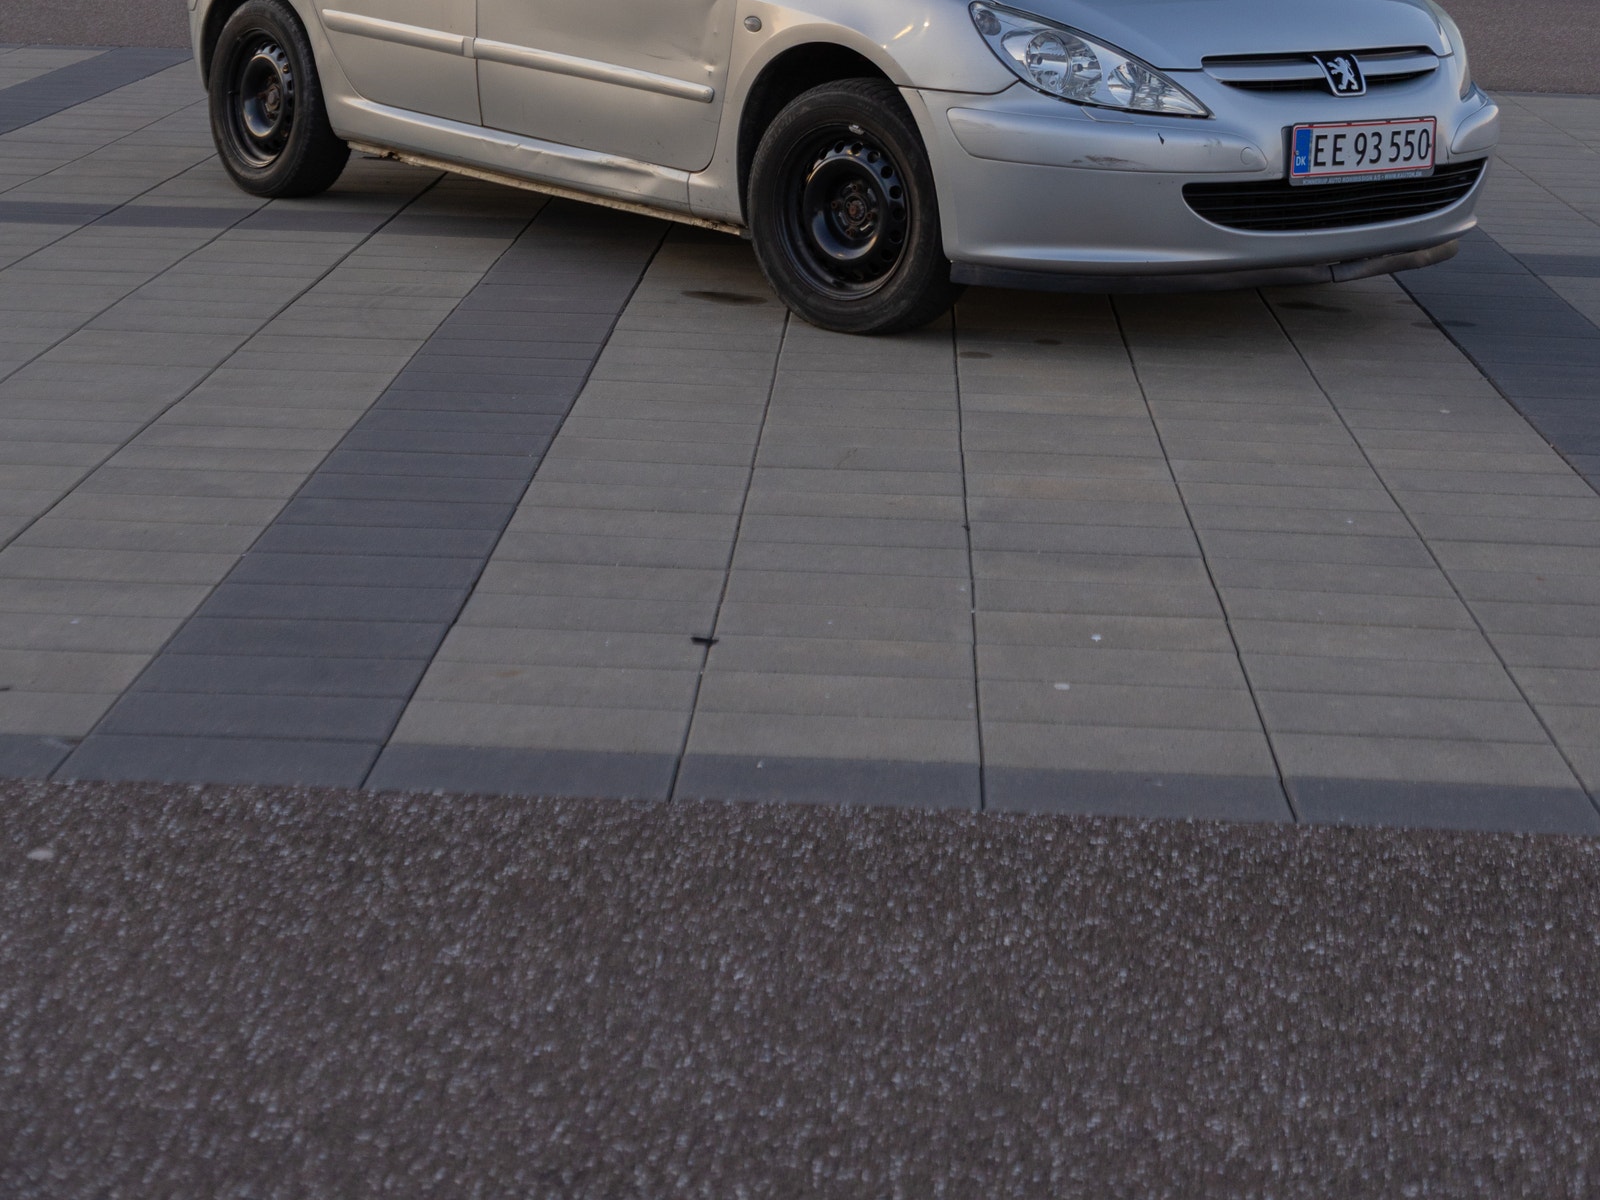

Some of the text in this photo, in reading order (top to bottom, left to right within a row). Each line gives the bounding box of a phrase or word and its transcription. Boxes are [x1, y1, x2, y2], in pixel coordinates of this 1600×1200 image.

[1314, 128, 1430, 167] EE 93 550
[1295, 155, 1307, 167] DK
